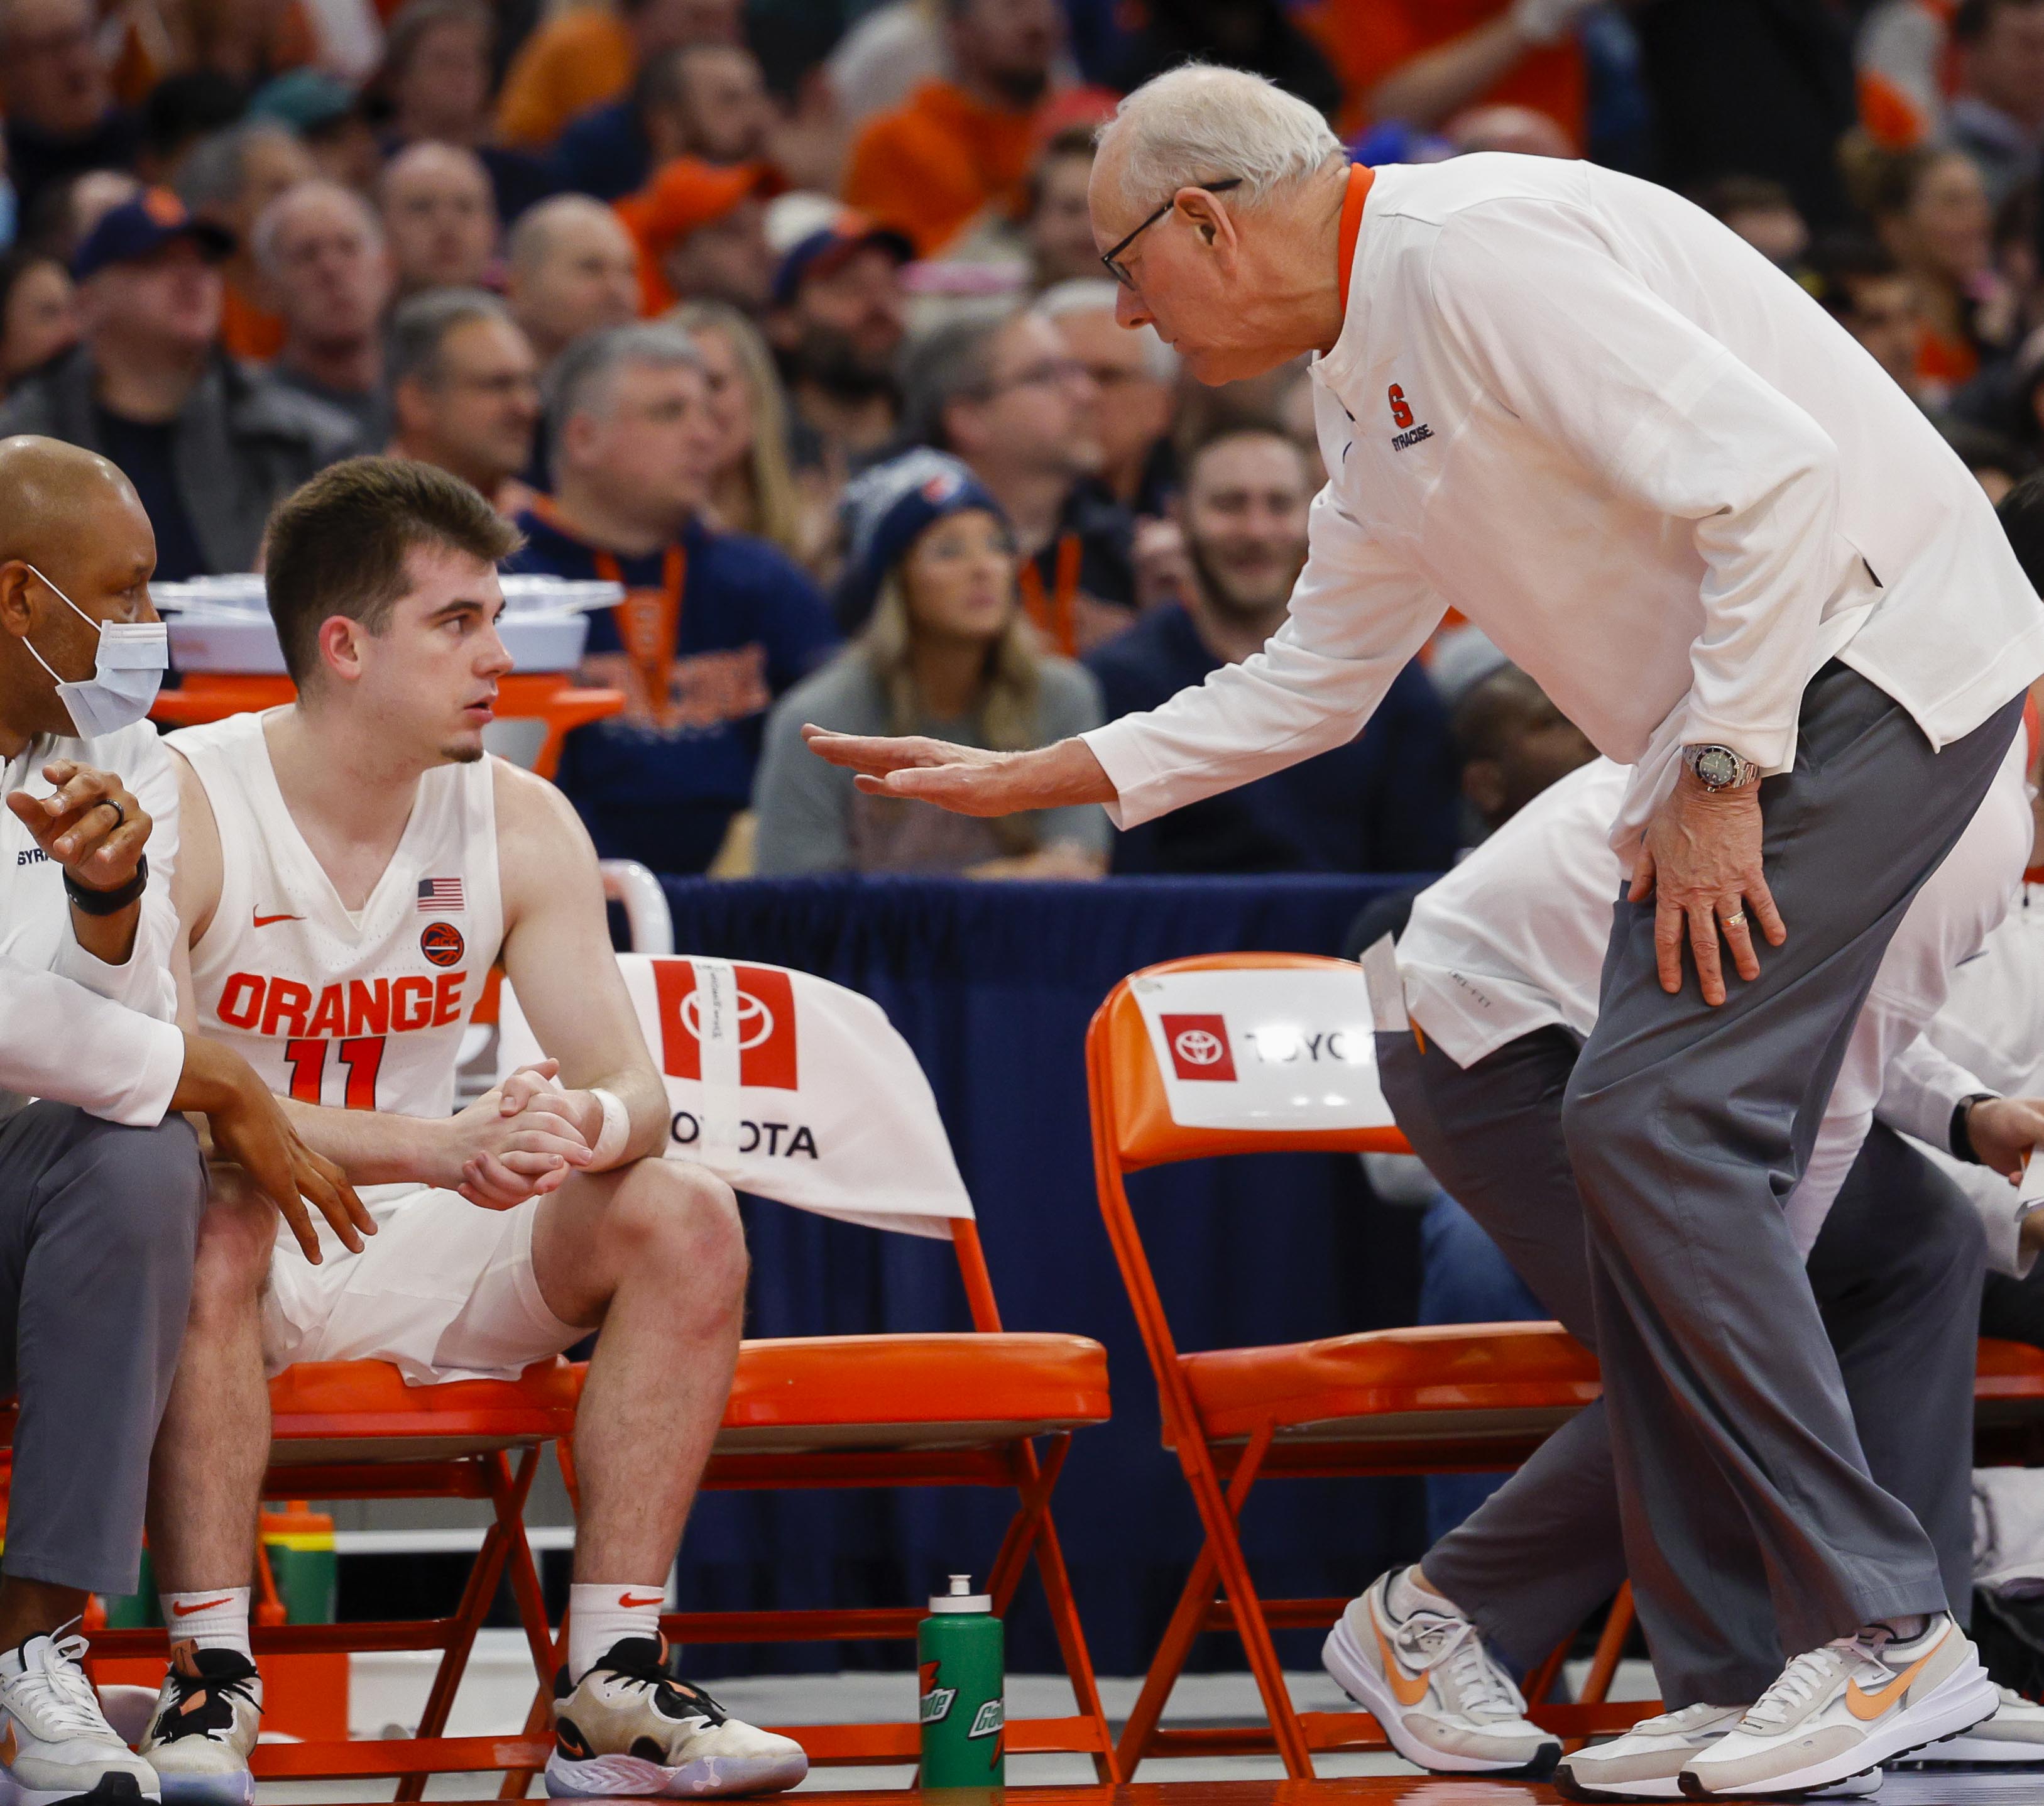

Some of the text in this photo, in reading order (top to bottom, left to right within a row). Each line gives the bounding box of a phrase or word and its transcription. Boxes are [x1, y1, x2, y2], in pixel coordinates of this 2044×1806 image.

[1388, 383, 1414, 429] S
[18, 848, 48, 865] SYR
[217, 971, 467, 1037] ORANGE
[285, 1036, 386, 1111] 11
[672, 1112, 818, 1159] OOTA
